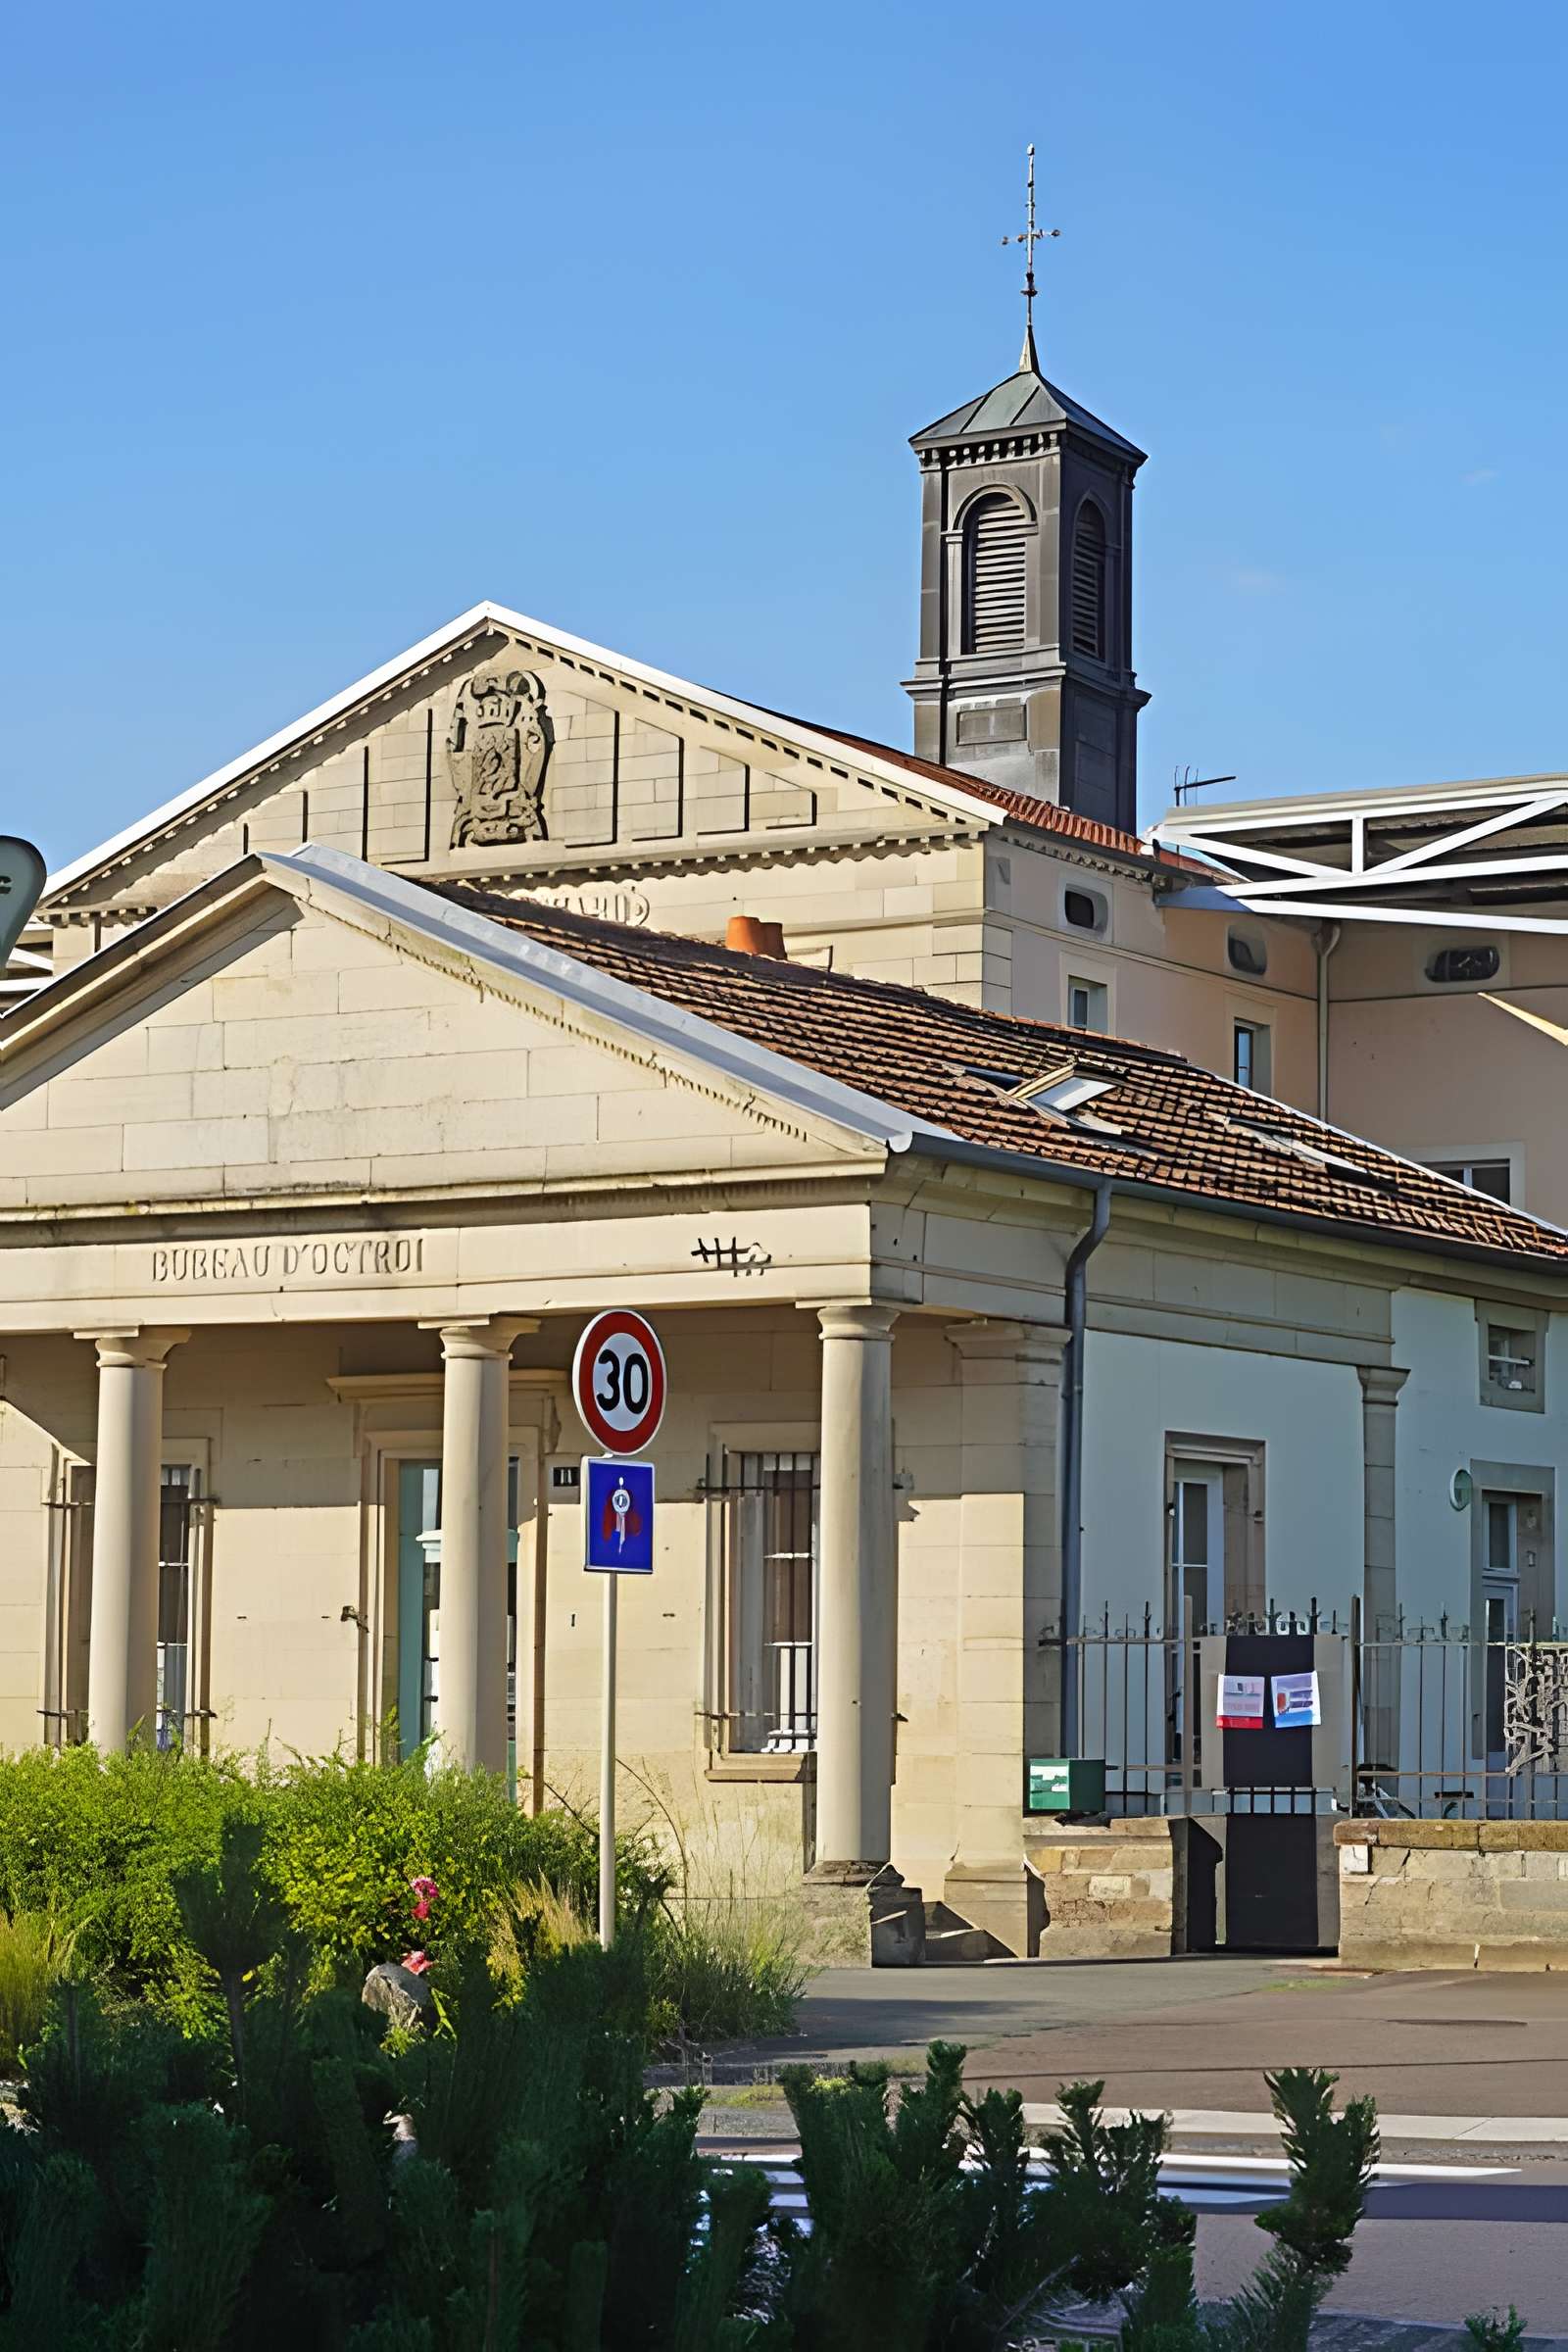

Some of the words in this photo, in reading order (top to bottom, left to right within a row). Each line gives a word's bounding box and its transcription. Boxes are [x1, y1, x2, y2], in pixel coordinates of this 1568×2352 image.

[152, 1245, 270, 1282] BUREAU
[283, 1237, 423, 1276] D'OCTROI
[596, 1348, 649, 1414] 30
